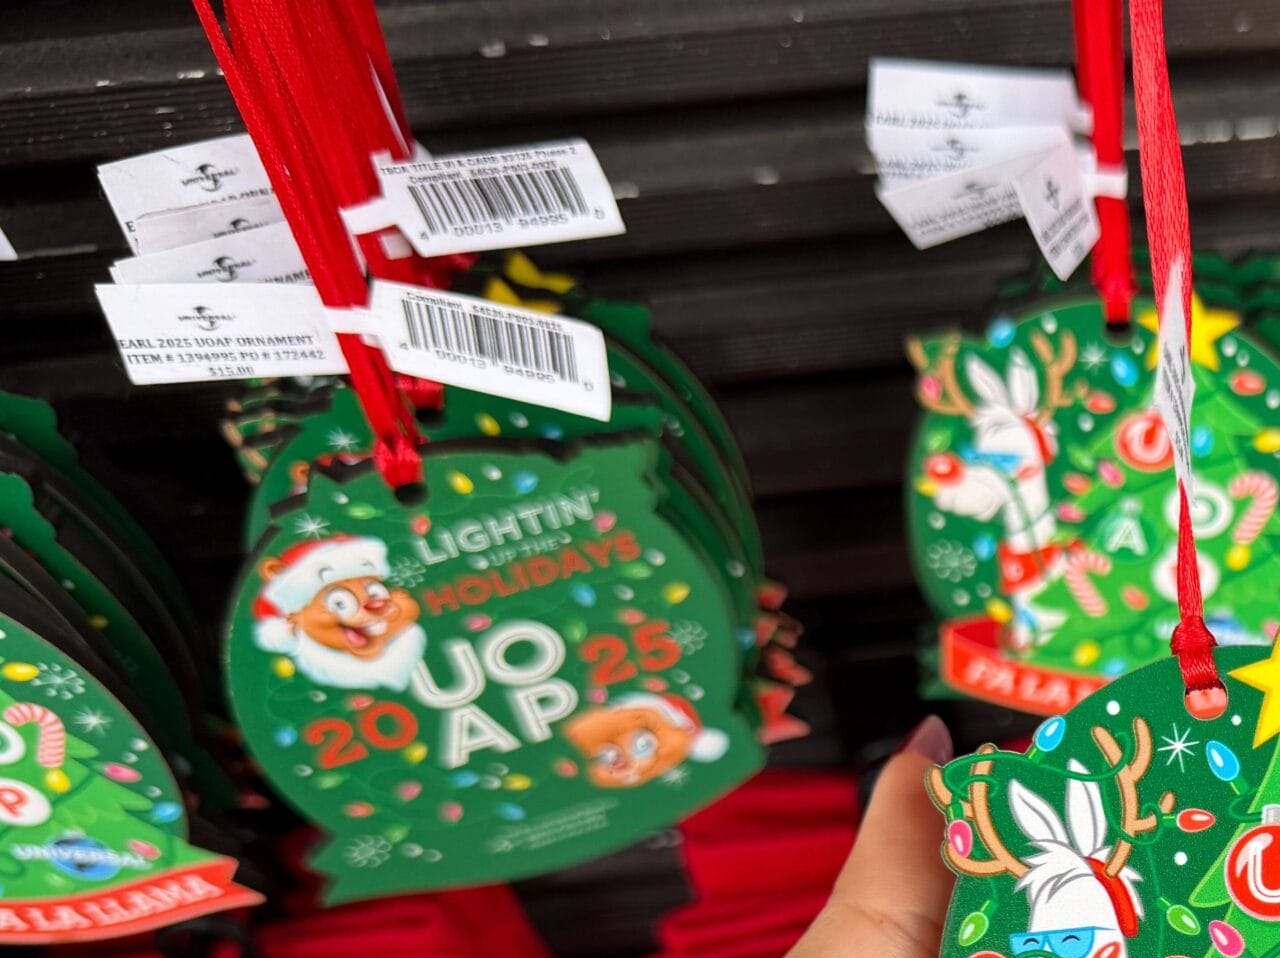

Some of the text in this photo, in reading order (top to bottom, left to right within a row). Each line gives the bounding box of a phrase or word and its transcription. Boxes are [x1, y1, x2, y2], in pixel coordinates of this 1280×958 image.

[119, 338, 156, 350] EARL
[157, 337, 193, 349] 2025
[236, 334, 315, 347] ORNAMENT
[127, 352, 163, 365] ITEM
[164, 353, 174, 362] #
[207, 365, 256, 377] $15.00
[1103, 515, 1149, 556] A
[422, 530, 643, 616] HOLIDAYS
